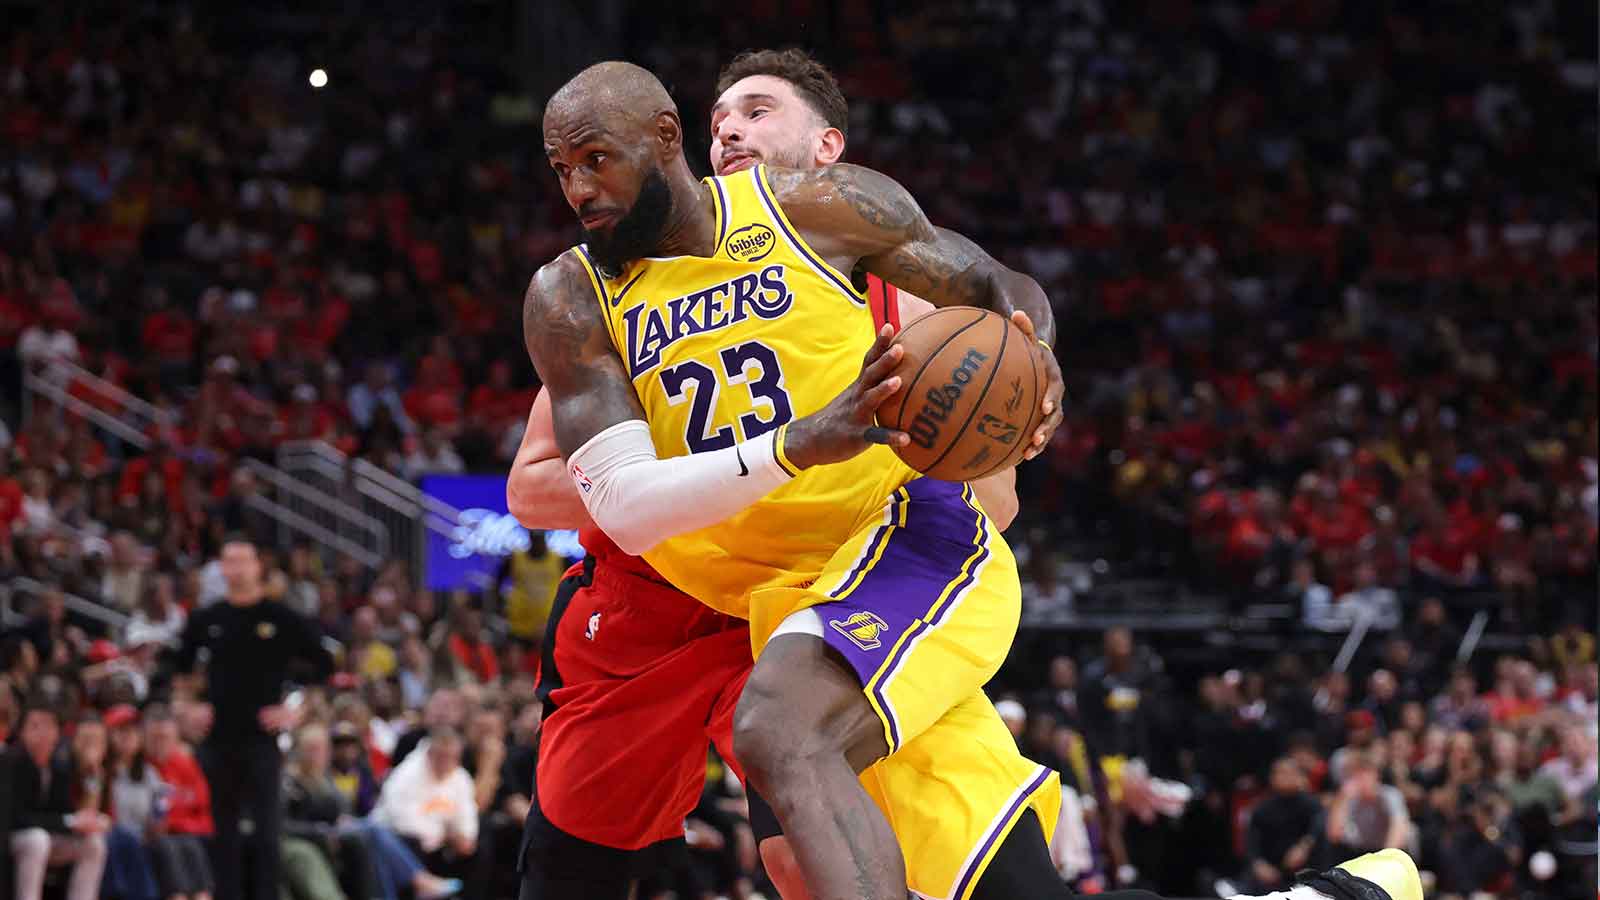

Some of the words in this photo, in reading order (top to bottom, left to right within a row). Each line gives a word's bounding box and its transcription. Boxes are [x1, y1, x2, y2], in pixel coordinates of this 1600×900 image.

[729, 232, 771, 253] bibigo
[623, 265, 793, 381] LAKERS
[660, 341, 792, 454] 23
[909, 347, 988, 449] Wilson
